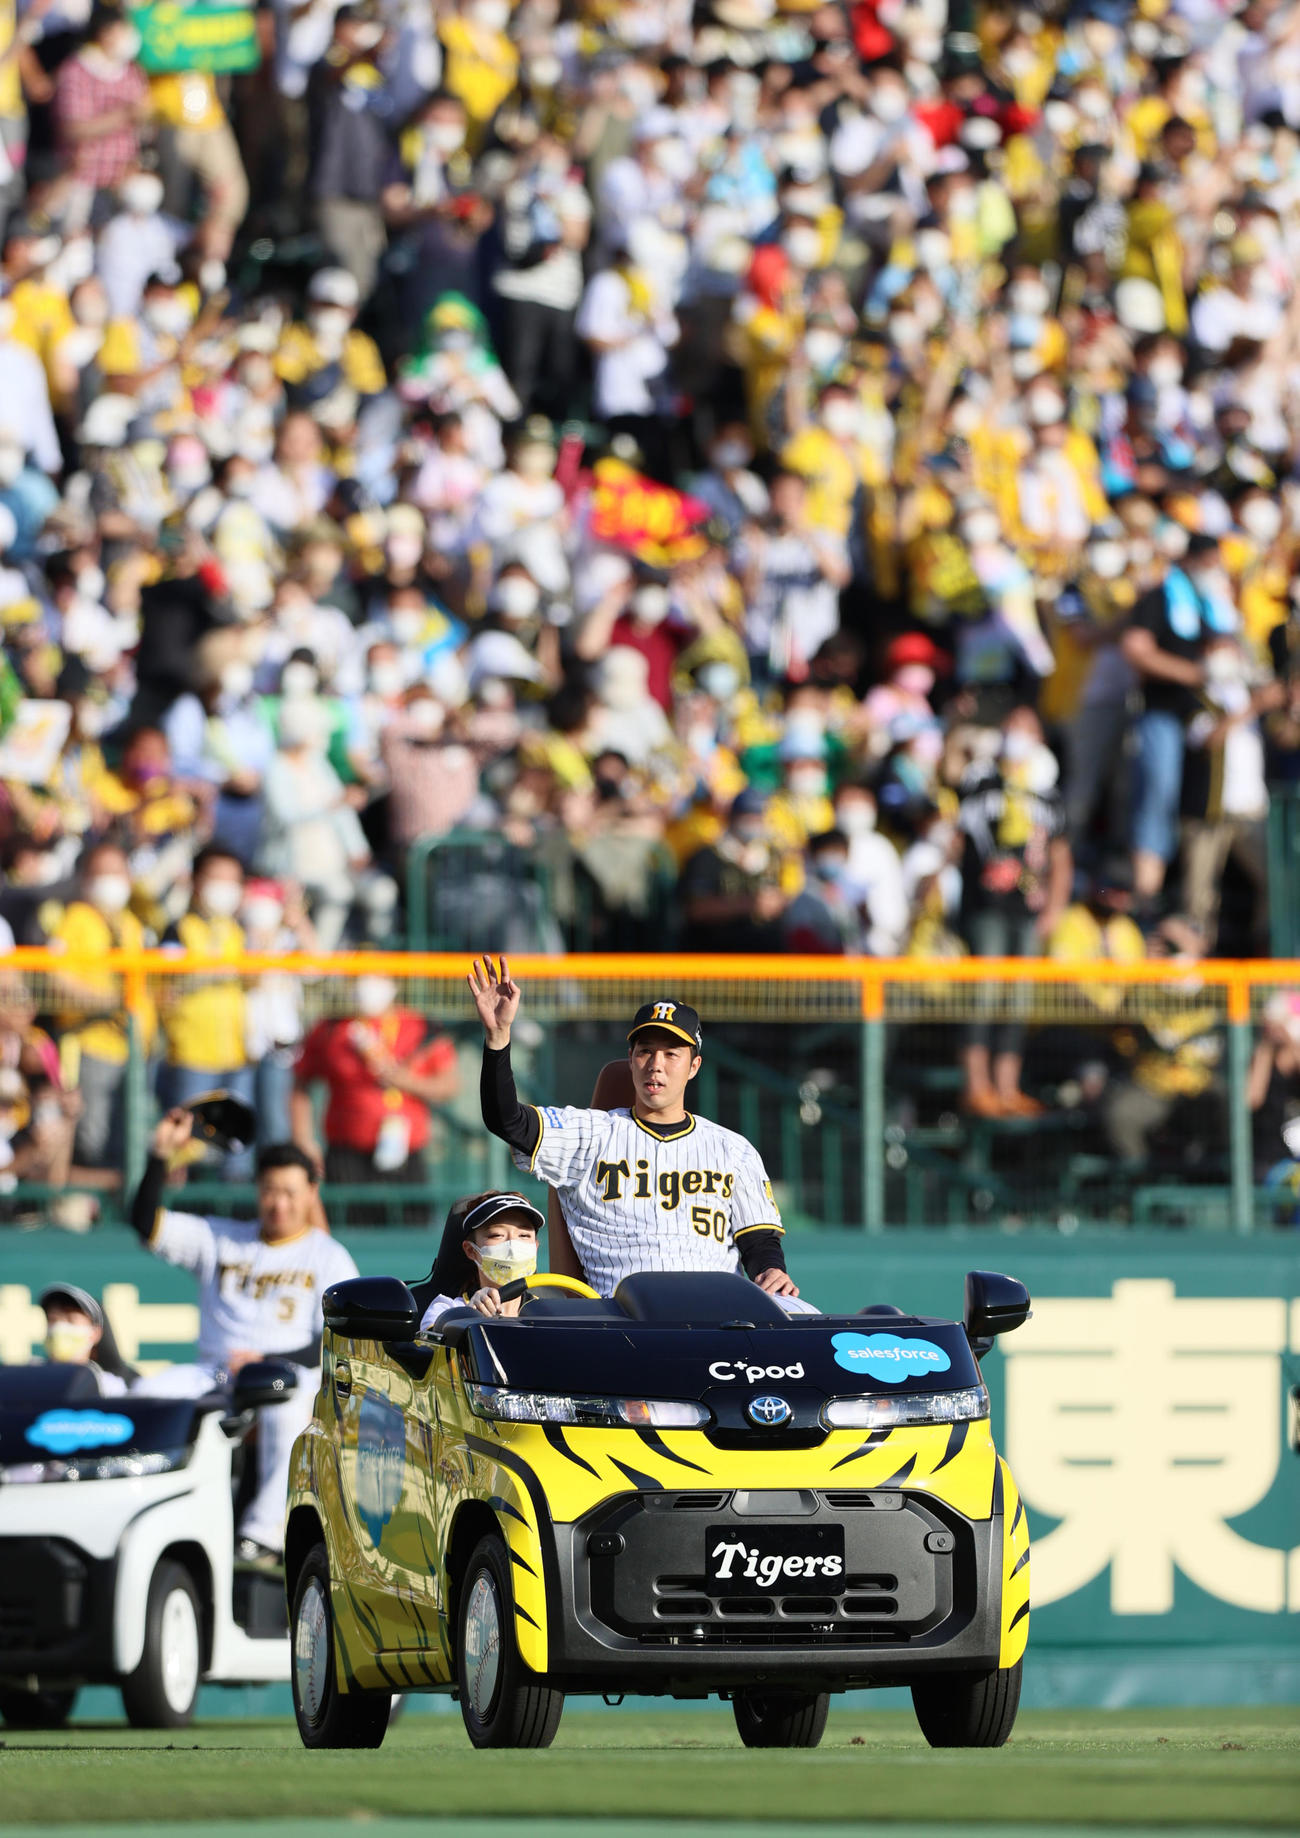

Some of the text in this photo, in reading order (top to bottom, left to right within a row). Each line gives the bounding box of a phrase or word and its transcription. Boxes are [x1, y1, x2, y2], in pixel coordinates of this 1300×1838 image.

[596, 1159, 734, 1210] Tigers
[692, 1206, 727, 1244] 50
[848, 1347, 940, 1361] salesforce
[998, 1278, 1300, 1616] 東
[711, 1541, 843, 1587] Tigers
